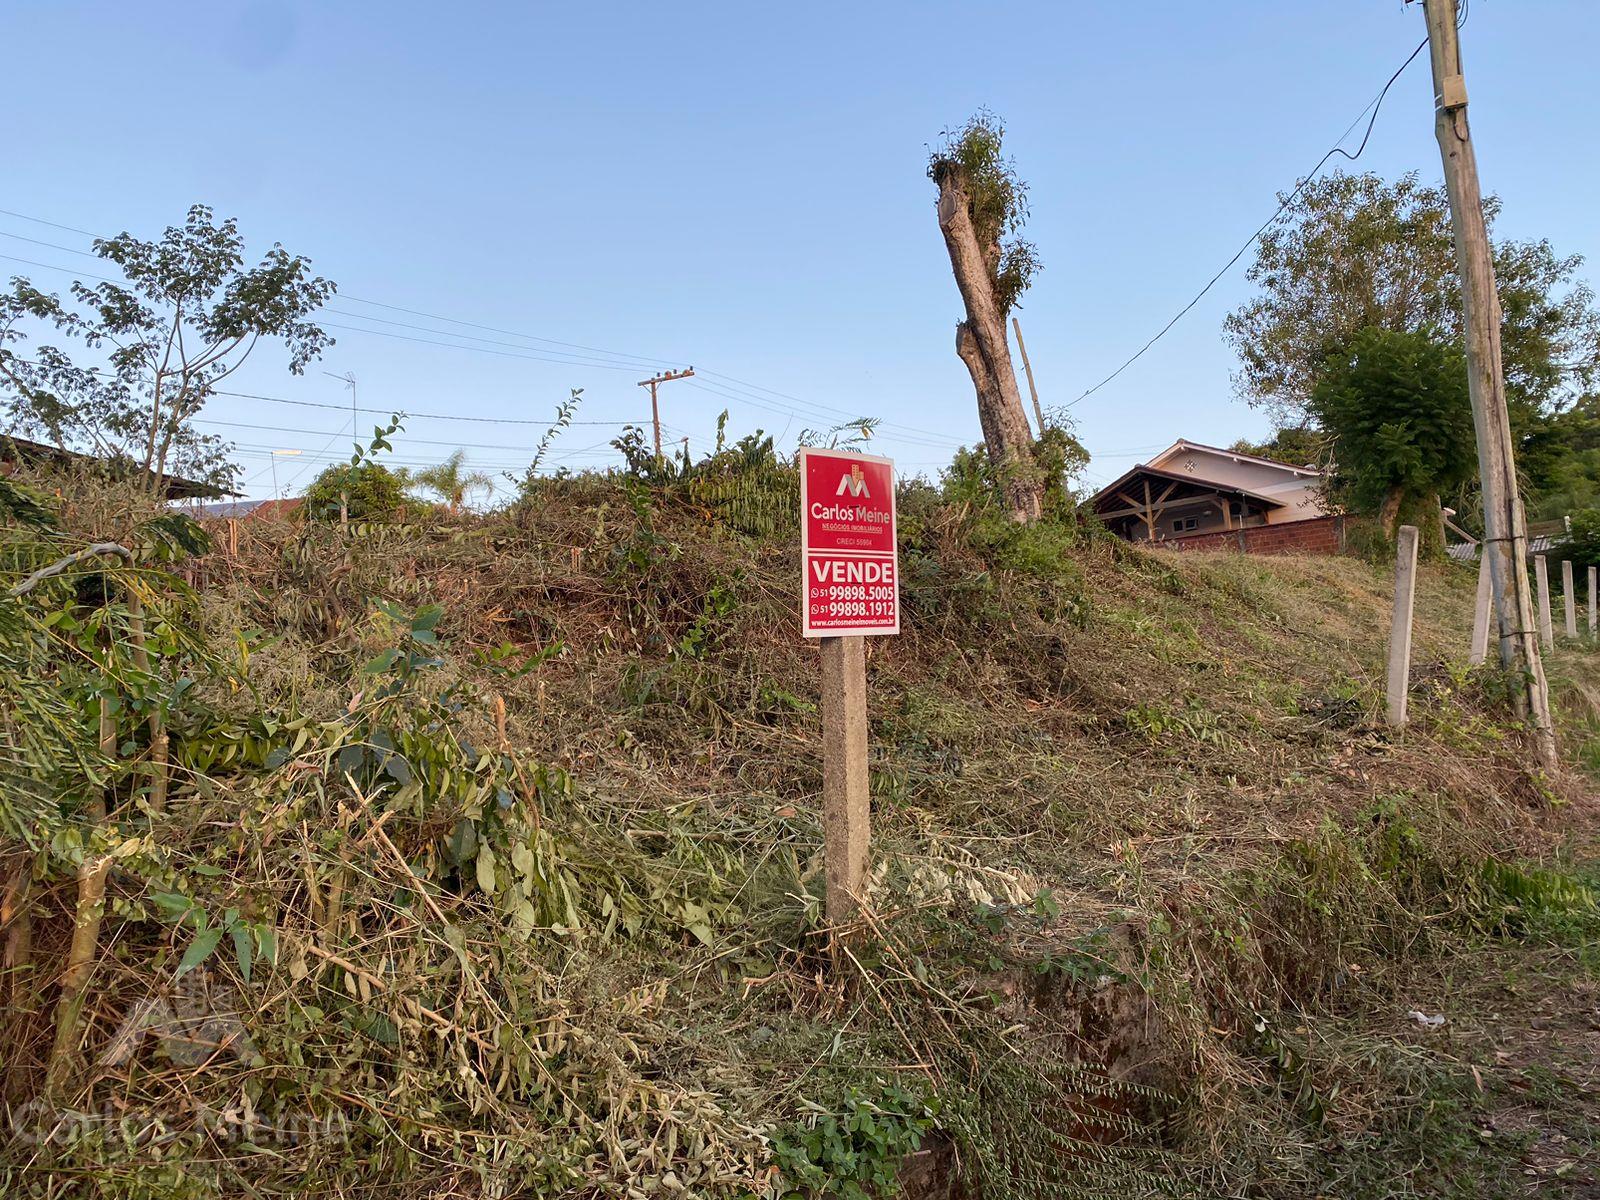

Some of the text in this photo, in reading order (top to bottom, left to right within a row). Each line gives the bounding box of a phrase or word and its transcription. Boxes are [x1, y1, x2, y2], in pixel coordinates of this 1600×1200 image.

[811, 502, 890, 524] Carlos Meine
[812, 561, 893, 583] VENDE
[820, 586, 894, 601] 51 99898.5005
[820, 602, 894, 617] 51 99898.1912
[811, 618, 894, 627] www.carlosmeineimoveis.com.br
